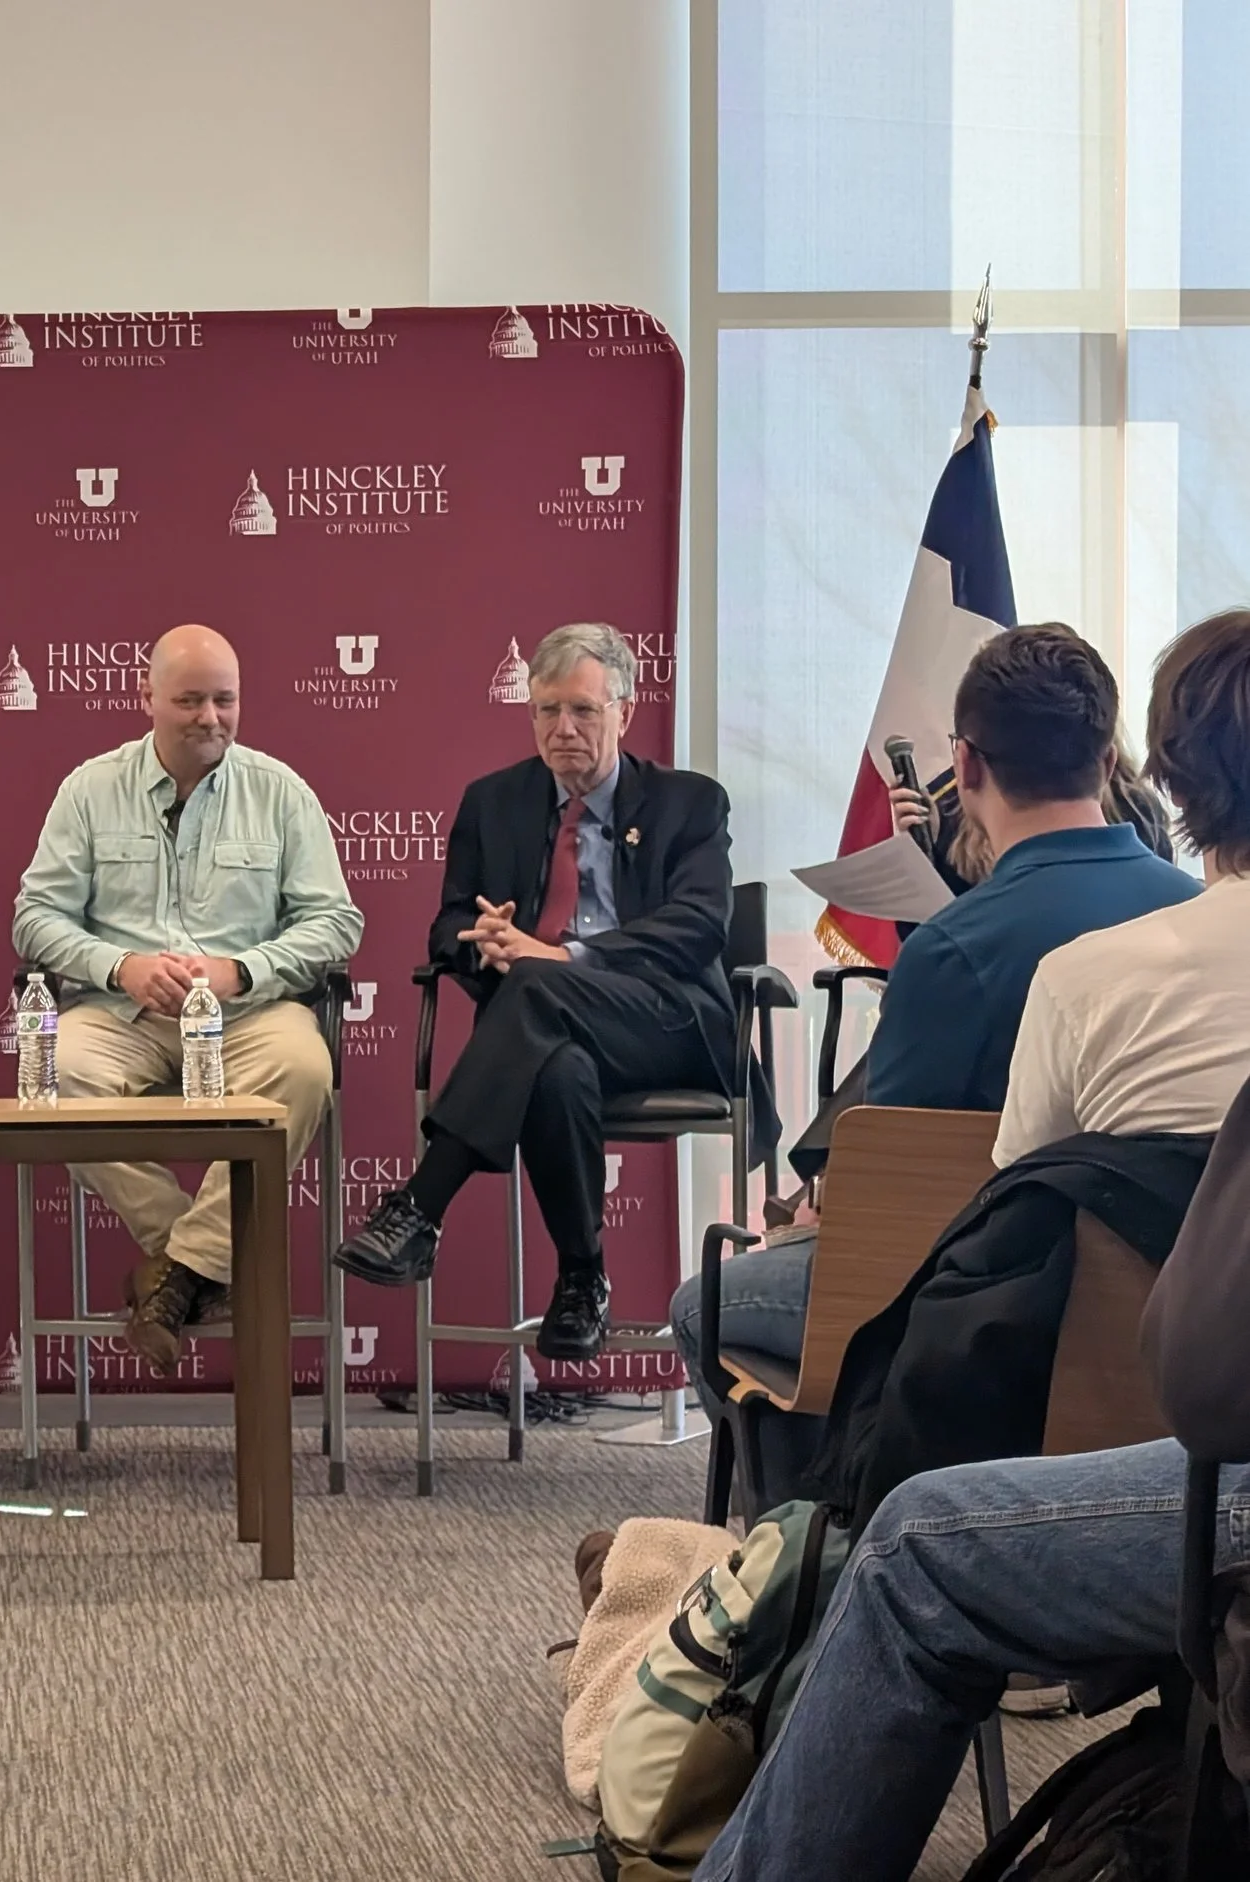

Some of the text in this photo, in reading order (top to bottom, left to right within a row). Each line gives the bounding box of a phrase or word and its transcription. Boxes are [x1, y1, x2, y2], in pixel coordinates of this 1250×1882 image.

[547, 313, 669, 341] INSTITU
[44, 324, 204, 349] INSTITUTE
[292, 334, 398, 349] UNIVERSITY
[588, 341, 676, 358] OF POLITICS
[81, 355, 166, 368] OF POLITICS
[312, 351, 379, 365] OF UTAH
[287, 464, 447, 491] HINCKLEY
[581, 456, 626, 496] U
[76, 468, 119, 507] U
[288, 490, 450, 517] INSTITUTE
[538, 499, 645, 515] UNIVERSITY
[35, 511, 140, 525] UNIVERSITY
[558, 517, 626, 531] OF UTAH
[55, 528, 120, 541] OF UTAH
[326, 522, 411, 534] OF POLITICS
[47, 642, 151, 666] HINCK
[336, 635, 379, 675] U
[48, 668, 149, 692] INSTIT
[294, 679, 398, 693] UNIVERSITY
[85, 699, 145, 711] OF POLIT
[314, 695, 379, 710] OF UTAH
[326, 811, 444, 836] NCKLEY
[336, 836, 447, 861] TITUTE
[347, 868, 408, 880] POLITICS
[346, 1043, 378, 1056] TAH
[88, 1216, 119, 1229] TAH
